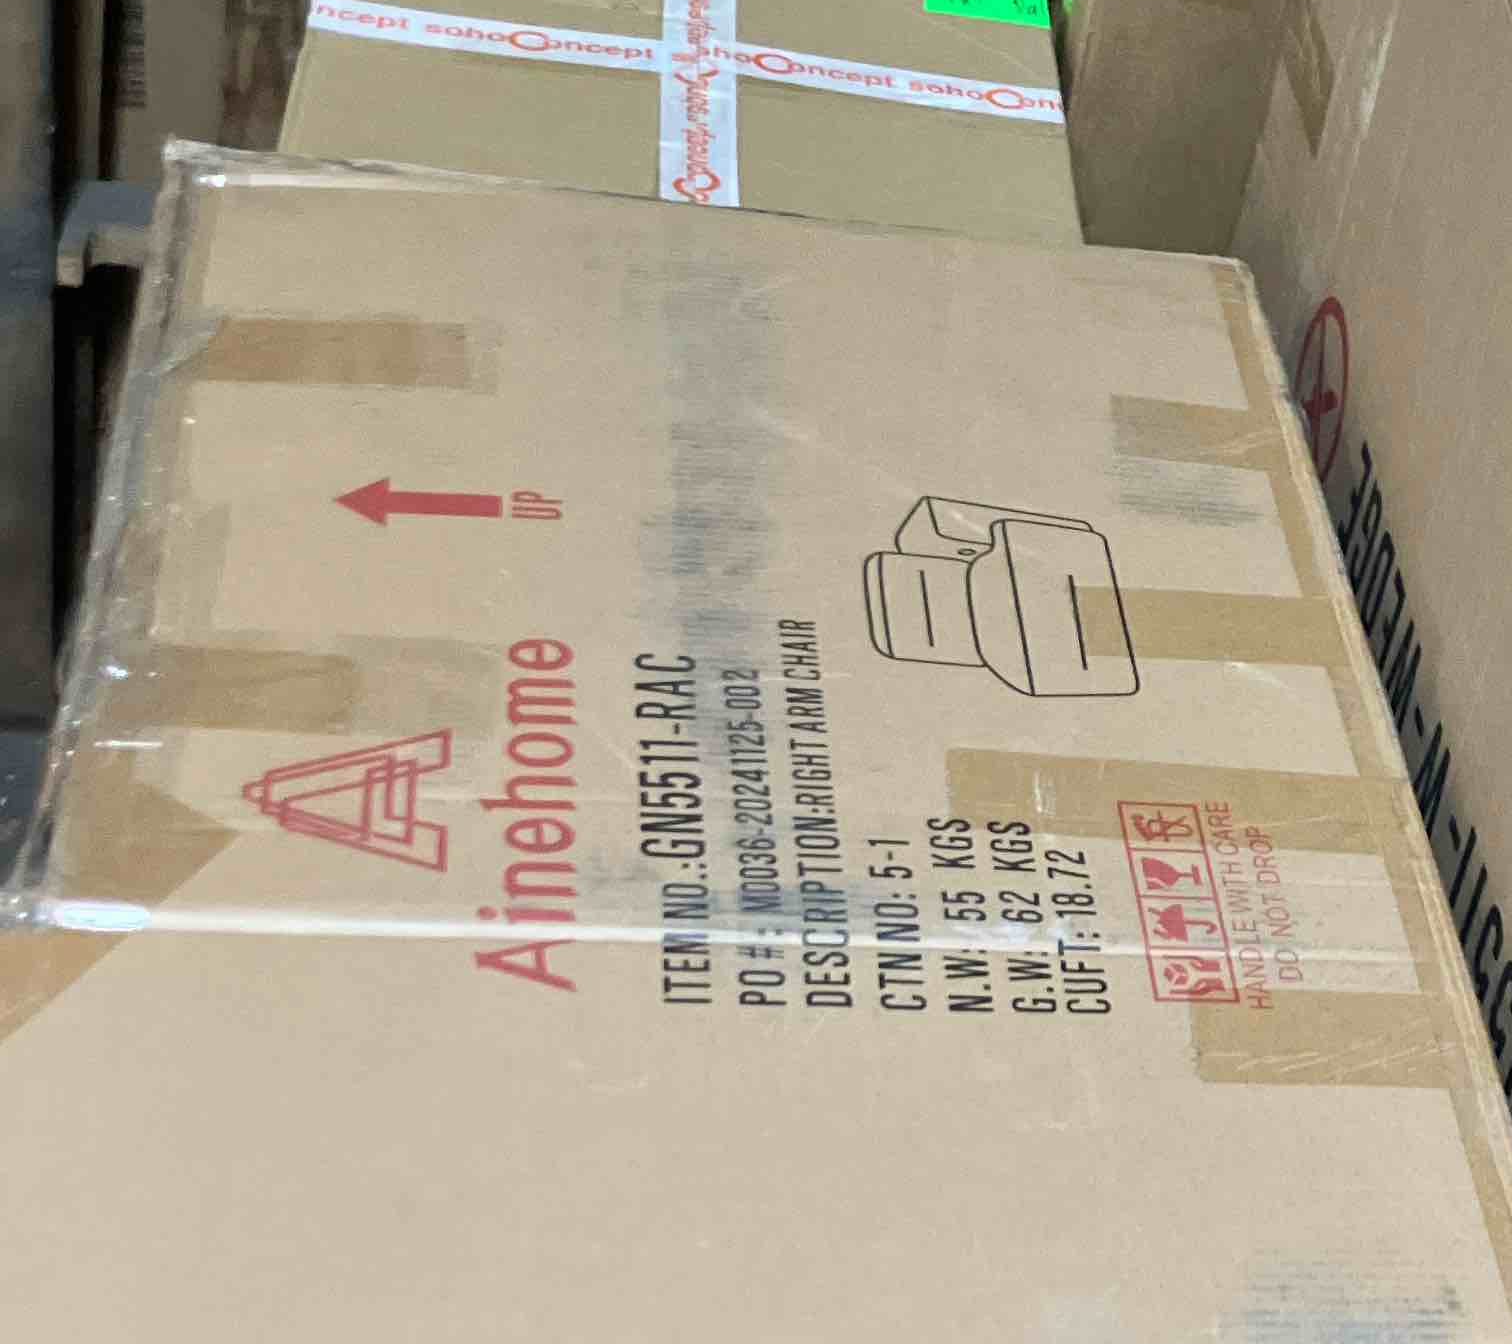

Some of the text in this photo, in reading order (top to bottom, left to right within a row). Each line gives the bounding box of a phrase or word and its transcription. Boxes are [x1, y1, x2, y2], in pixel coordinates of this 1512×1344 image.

[510, 490, 565, 522] UP
[777, 618, 822, 683] CHAIR
[784, 686, 829, 735] ARM
[473, 637, 578, 993] Ainehome
[926, 817, 976, 870] KGS
[986, 820, 1037, 873] KGS
[941, 890, 987, 922] 55
[998, 890, 1044, 923] 62
[1044, 849, 1098, 918] 18.72
[1205, 799, 1275, 1009] HANDLE WITH CARE
[1245, 824, 1304, 984] DO NOT DROP
[867, 838, 928, 1011] CTN NO: 5-1
[662, 932, 713, 1005] ITEM
[737, 969, 788, 1007] PO
